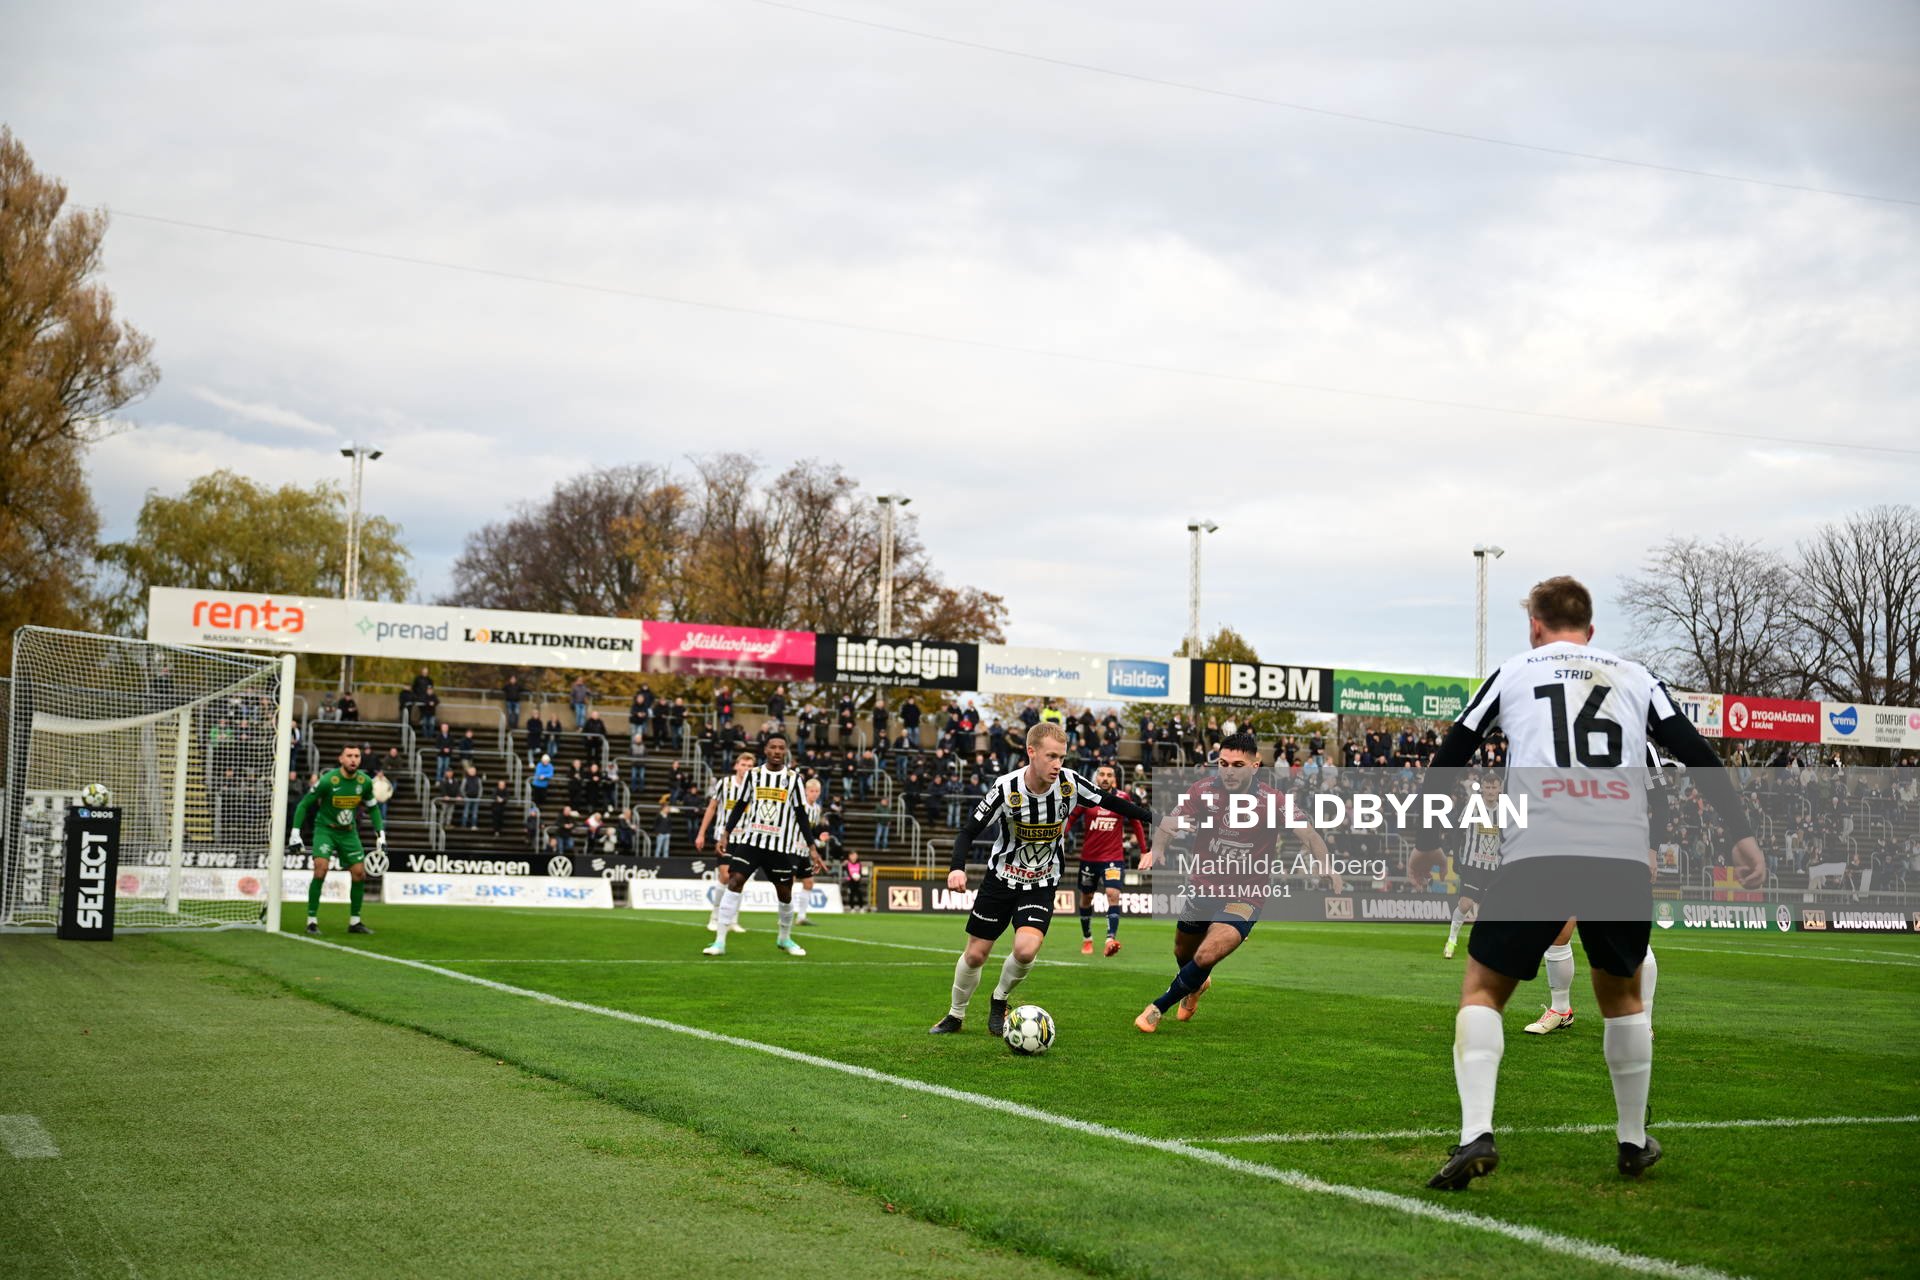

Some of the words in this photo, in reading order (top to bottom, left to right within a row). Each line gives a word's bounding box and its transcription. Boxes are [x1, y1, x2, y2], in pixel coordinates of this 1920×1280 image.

[192, 599, 305, 633] renta
[376, 621, 448, 642] prenad
[464, 628, 634, 652] LOKALTIDNINGEN
[836, 636, 959, 680] infosign
[985, 663, 1080, 680] Handelsbanken
[1111, 669, 1166, 689] Haldex
[1554, 669, 1593, 680] STRID
[1230, 662, 1320, 702] BBM
[1341, 687, 1376, 700] Allmän
[1377, 692, 1405, 703] nytta.
[1341, 699, 1357, 710] För
[1358, 700, 1380, 711] allas
[1383, 702, 1411, 714] bästa.
[1534, 683, 1623, 770] 16
[1755, 721, 1774, 730] SKÅNE
[1875, 713, 1907, 726] COMFORT
[1541, 778, 1630, 800] PULS
[409, 854, 530, 876] Volkswagen
[601, 865, 659, 880] alfdex
[77, 831, 108, 929] SELECT
[402, 883, 452, 896] SKF
[476, 884, 525, 897] SKF
[547, 886, 595, 899] SKF
[642, 888, 701, 902] FUTURE
[1361, 899, 1451, 920] LANDSKRONA
[1683, 904, 1767, 929] SUPERETTAN
[1832, 911, 1908, 930] LANDSKRONA
